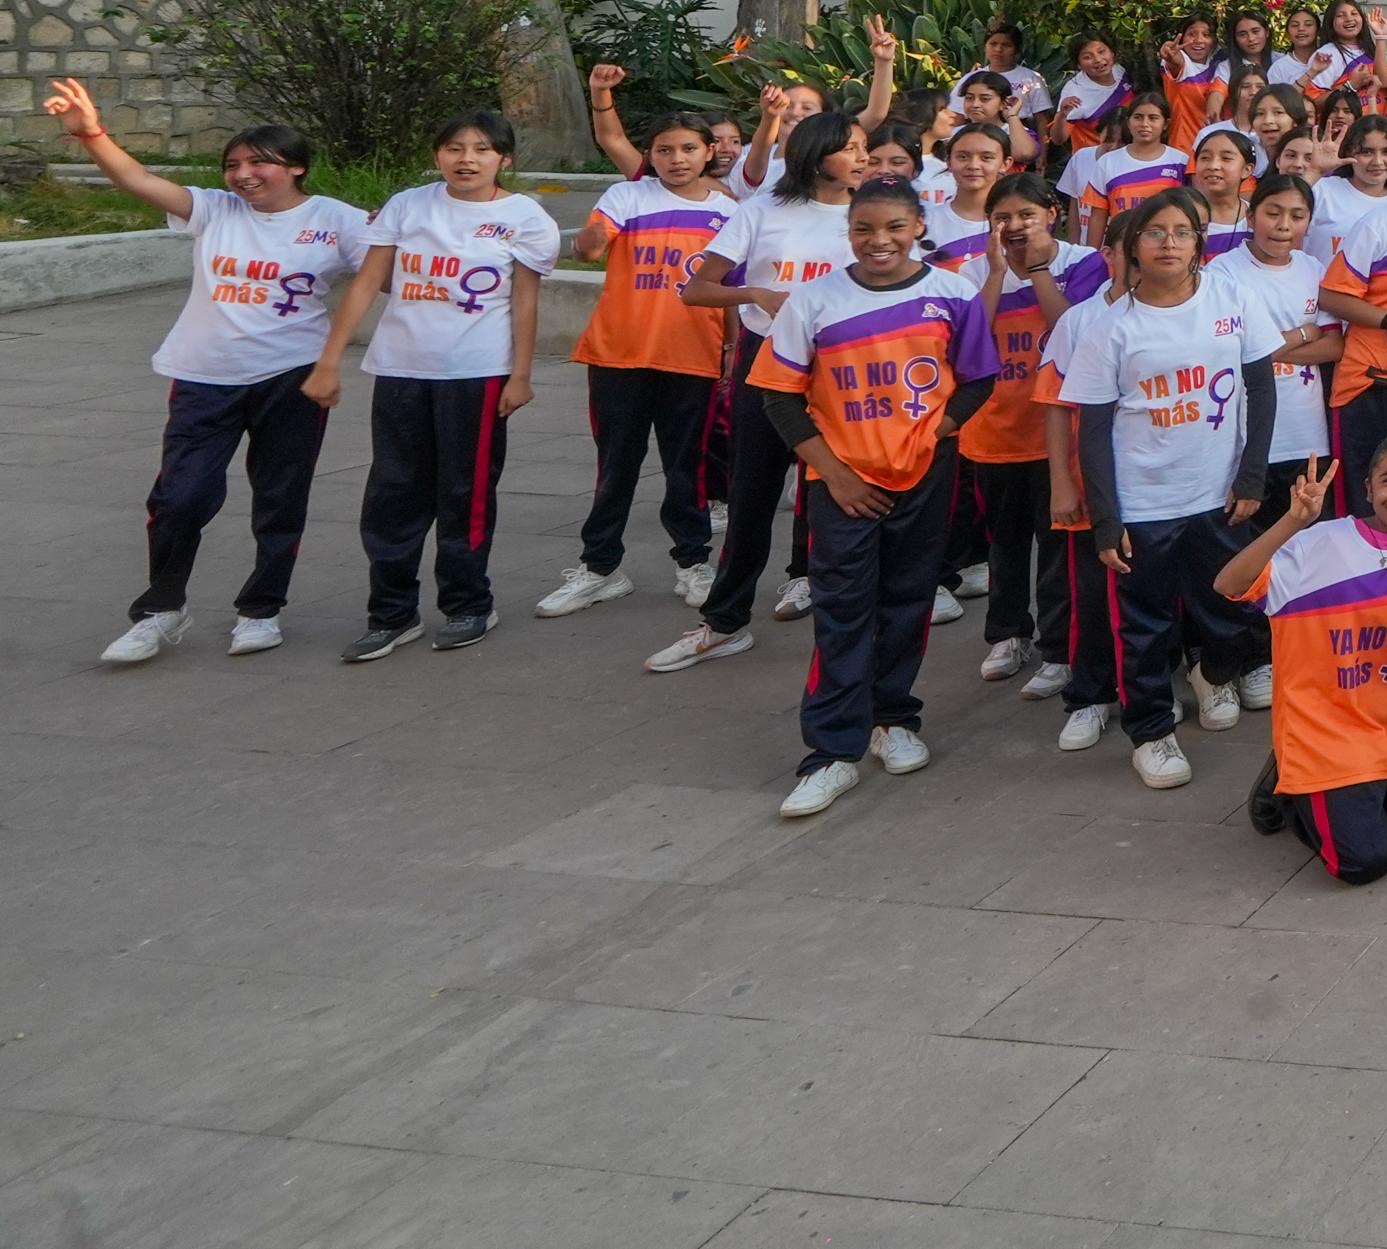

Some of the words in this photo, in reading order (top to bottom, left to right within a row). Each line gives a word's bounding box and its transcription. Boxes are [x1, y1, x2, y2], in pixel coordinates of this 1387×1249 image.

[212, 255, 237, 277] YA
[246, 260, 280, 280] NO
[401, 252, 422, 274] YA
[430, 256, 460, 277] NO
[633, 246, 656, 265] YA
[213, 282, 269, 304] más
[402, 280, 449, 302] más
[1305, 298, 1318, 315] 25
[1008, 332, 1032, 352] NO
[831, 365, 856, 390] YA
[867, 360, 897, 386] NO
[997, 357, 1027, 381] ás
[1139, 376, 1169, 400] YA
[1177, 365, 1205, 392] NO
[844, 393, 892, 422] más
[1149, 399, 1200, 429] más
[1329, 628, 1353, 653] YA
[1357, 625, 1387, 651] NO
[1337, 659, 1372, 690] más
